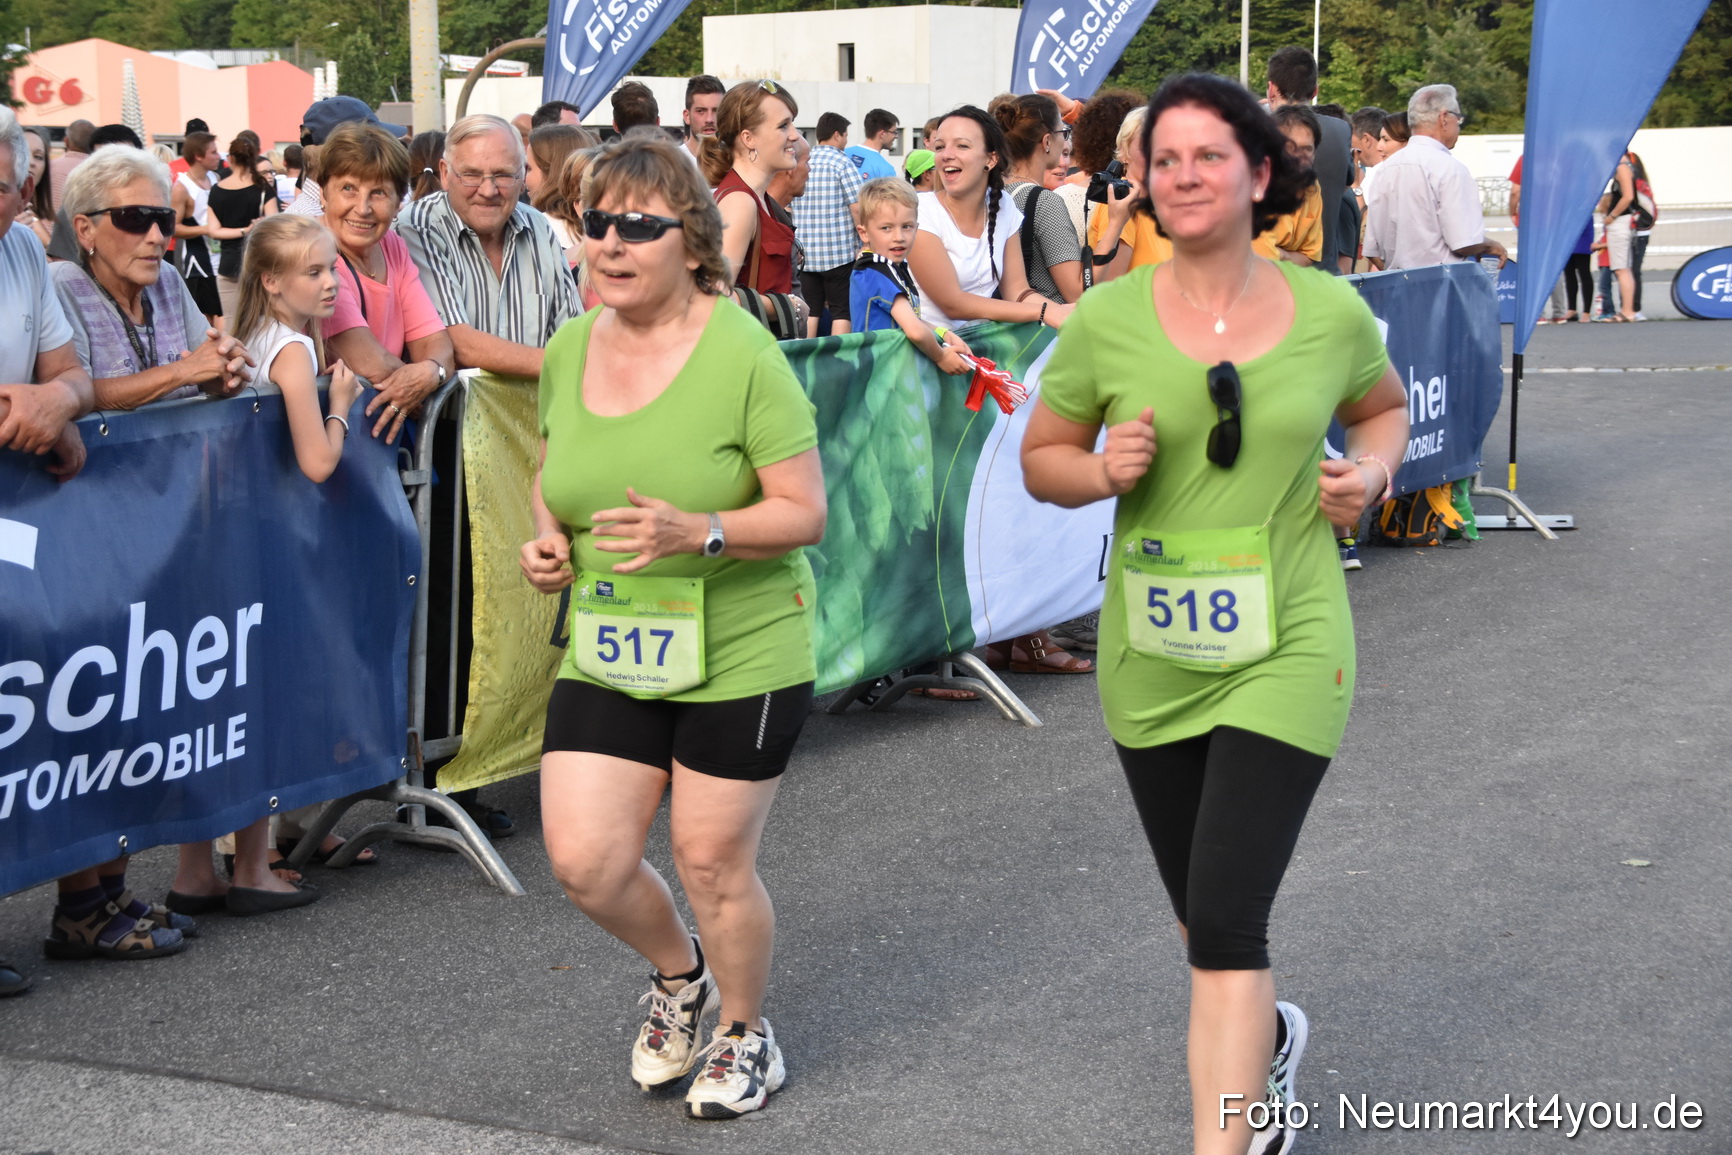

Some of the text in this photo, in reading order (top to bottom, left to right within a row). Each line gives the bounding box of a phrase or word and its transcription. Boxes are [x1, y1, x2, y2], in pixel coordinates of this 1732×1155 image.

[23, 76, 84, 106] G6
[1147, 586, 1239, 633] 518
[597, 625, 674, 666] 517
[1162, 638, 1227, 652] Yvonne Kaiser
[606, 671, 669, 683] Hedwig Schaller
